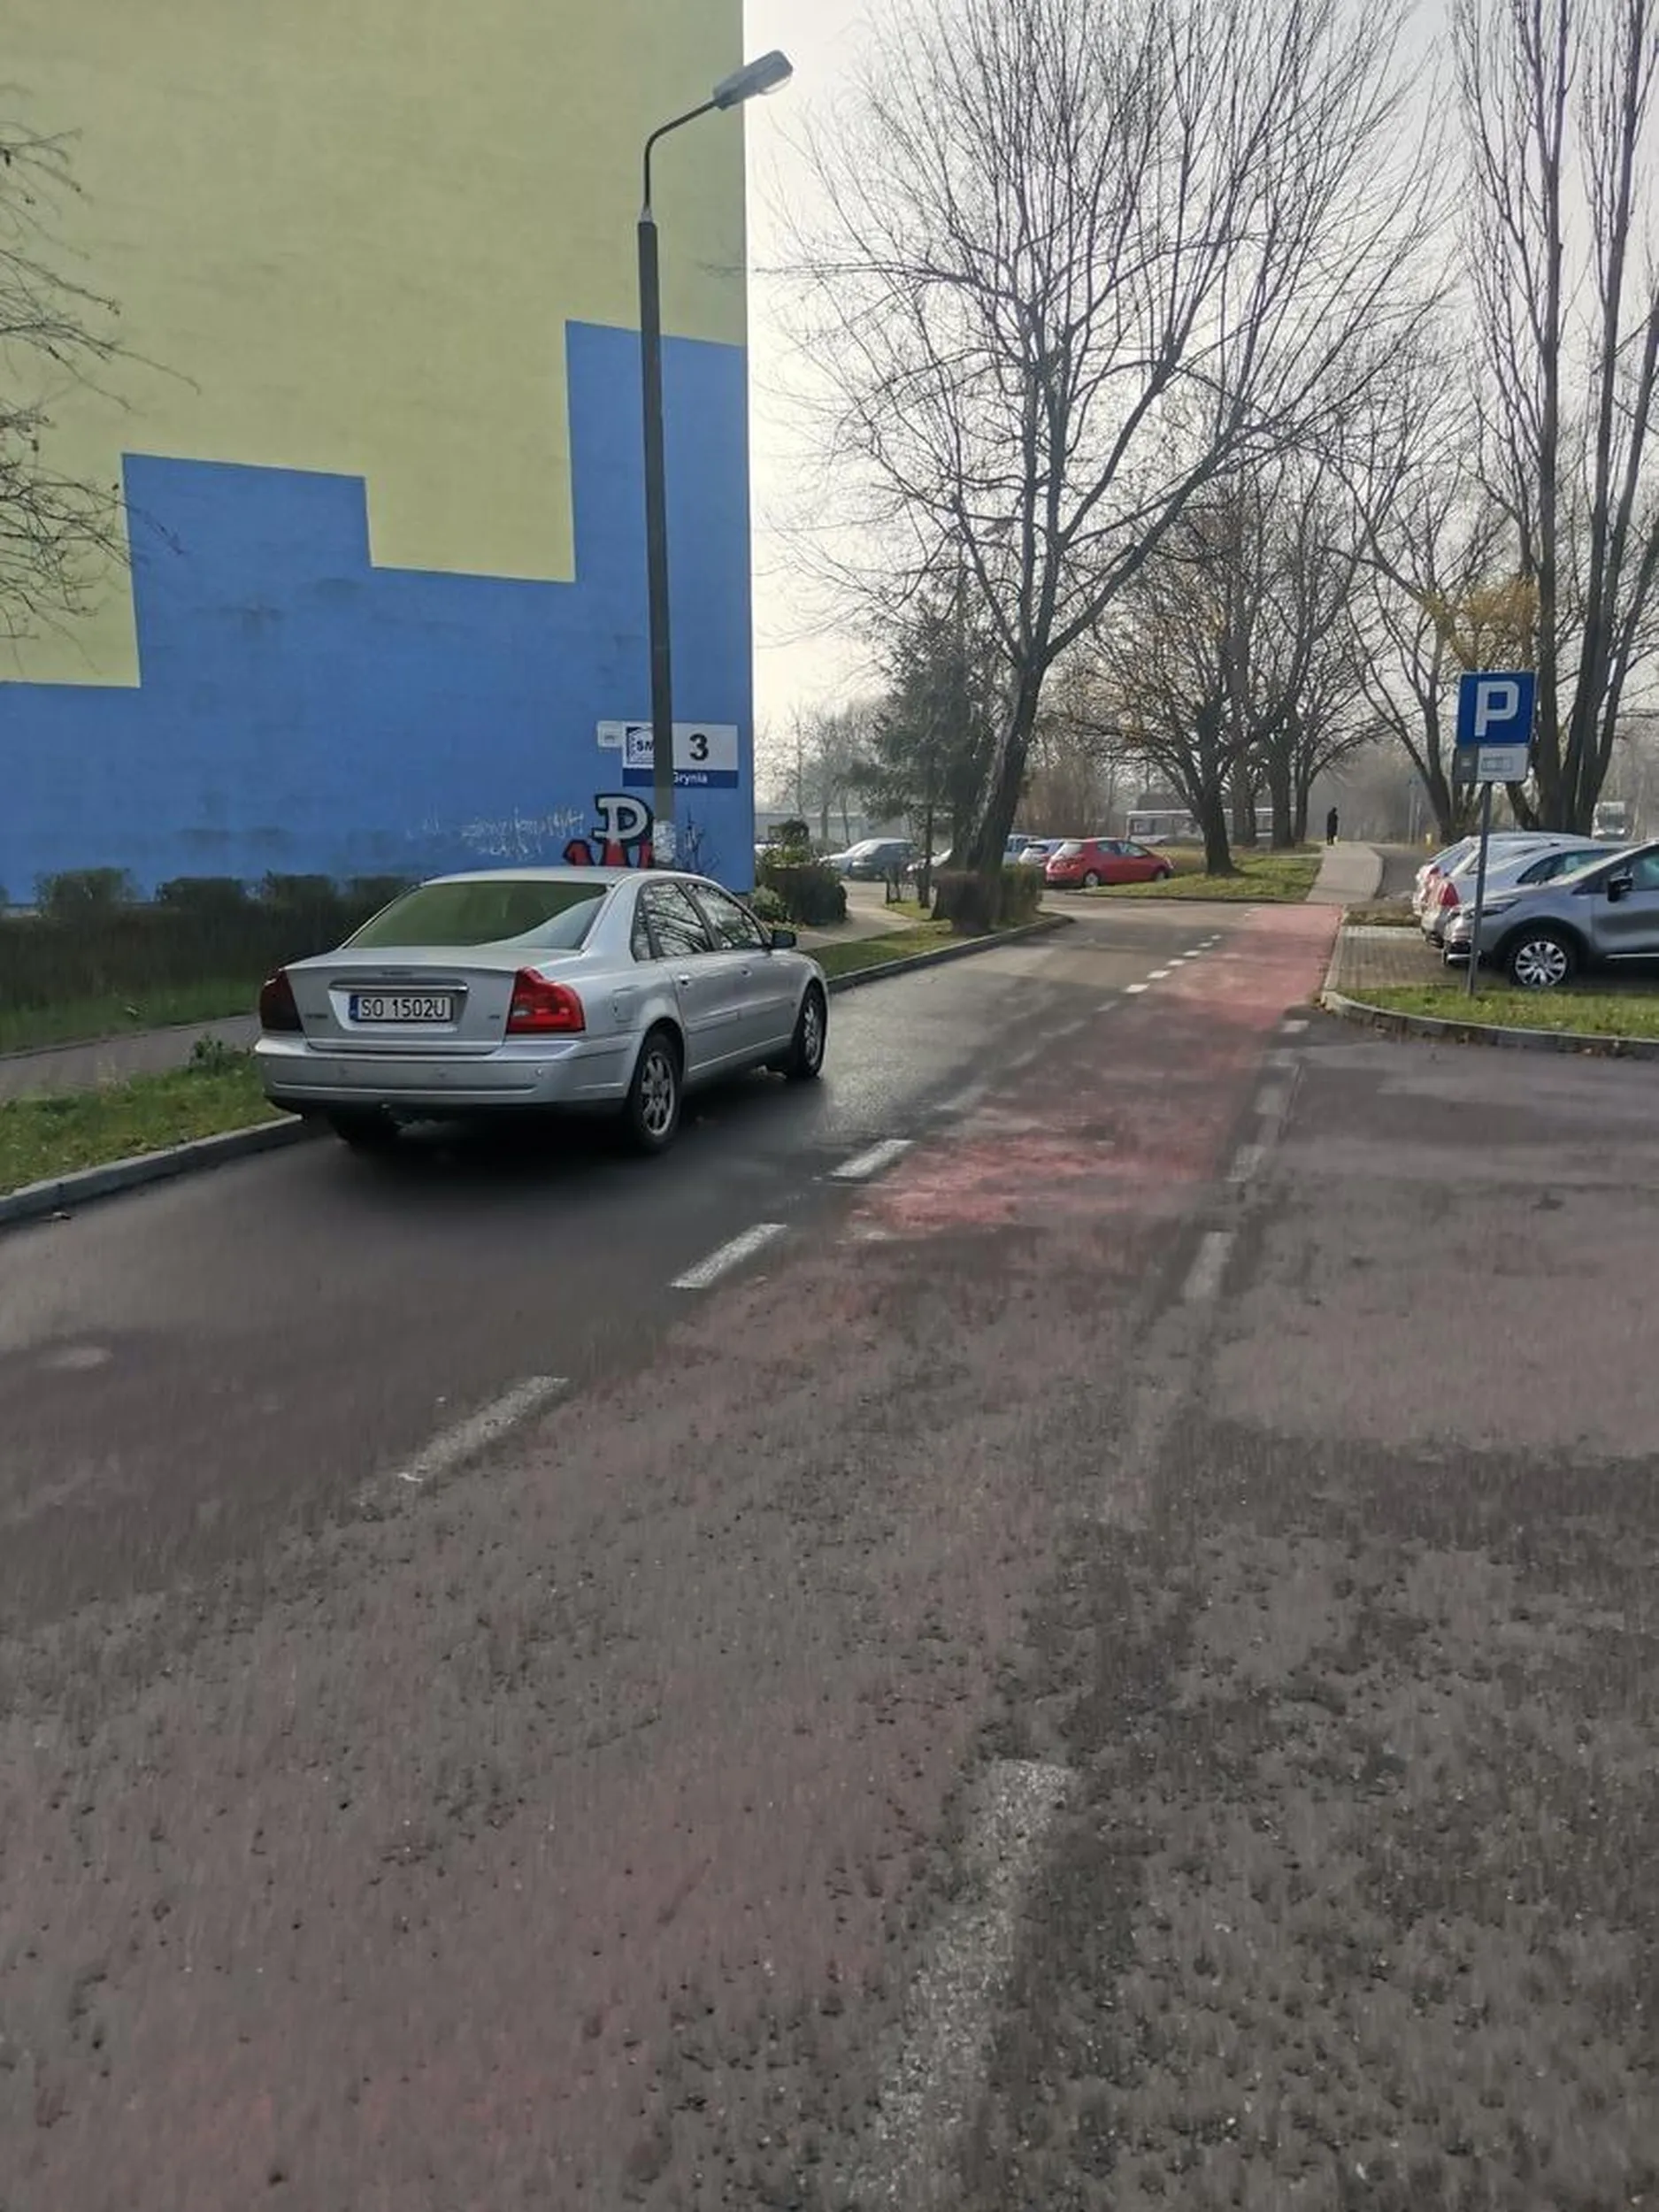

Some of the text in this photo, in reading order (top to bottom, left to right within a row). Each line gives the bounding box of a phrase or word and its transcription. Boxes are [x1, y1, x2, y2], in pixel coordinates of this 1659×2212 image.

[1474, 680, 1519, 737] P
[689, 733, 709, 761] 3
[361, 998, 445, 1018] SO 1502U
